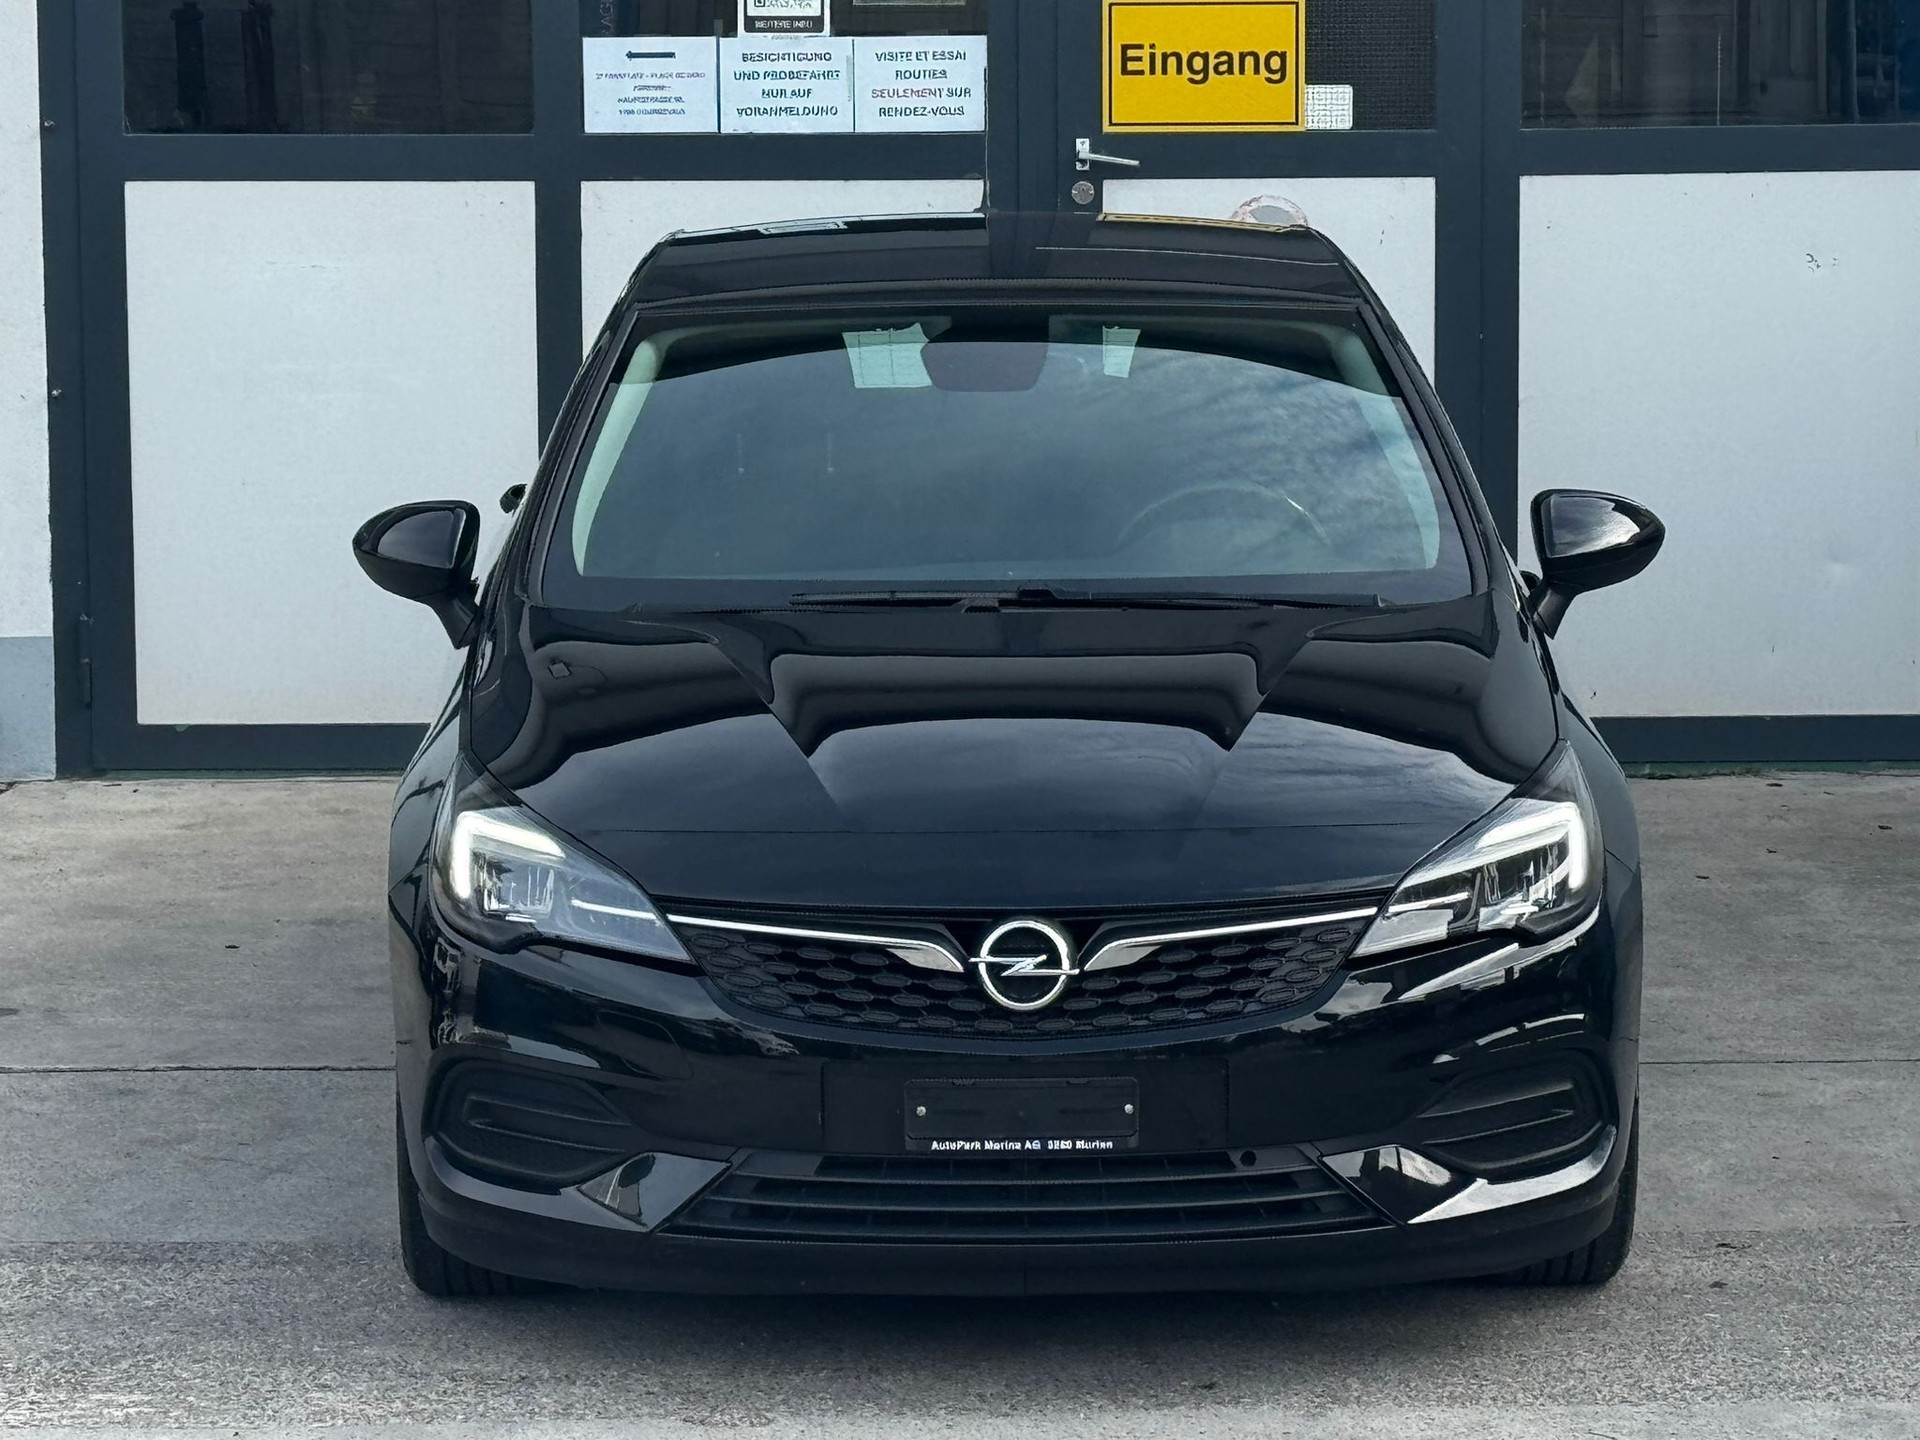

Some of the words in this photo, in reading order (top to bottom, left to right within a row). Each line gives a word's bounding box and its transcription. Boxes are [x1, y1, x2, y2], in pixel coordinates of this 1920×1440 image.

[742, 52, 832, 62] BESICHTIGUNG
[875, 51, 912, 62] VISITE
[916, 51, 929, 61] ET
[932, 50, 967, 60] ESSAI
[1120, 43, 1287, 84] Eingang
[734, 70, 760, 81] UND
[762, 88, 787, 99] NUR
[871, 88, 944, 99] SEULEMENT
[946, 87, 972, 98] SUR
[737, 105, 839, 117] VORANMELDUNG
[879, 106, 965, 117] RENDEZ-VOUS
[1024, 1140, 1041, 1150] AG
